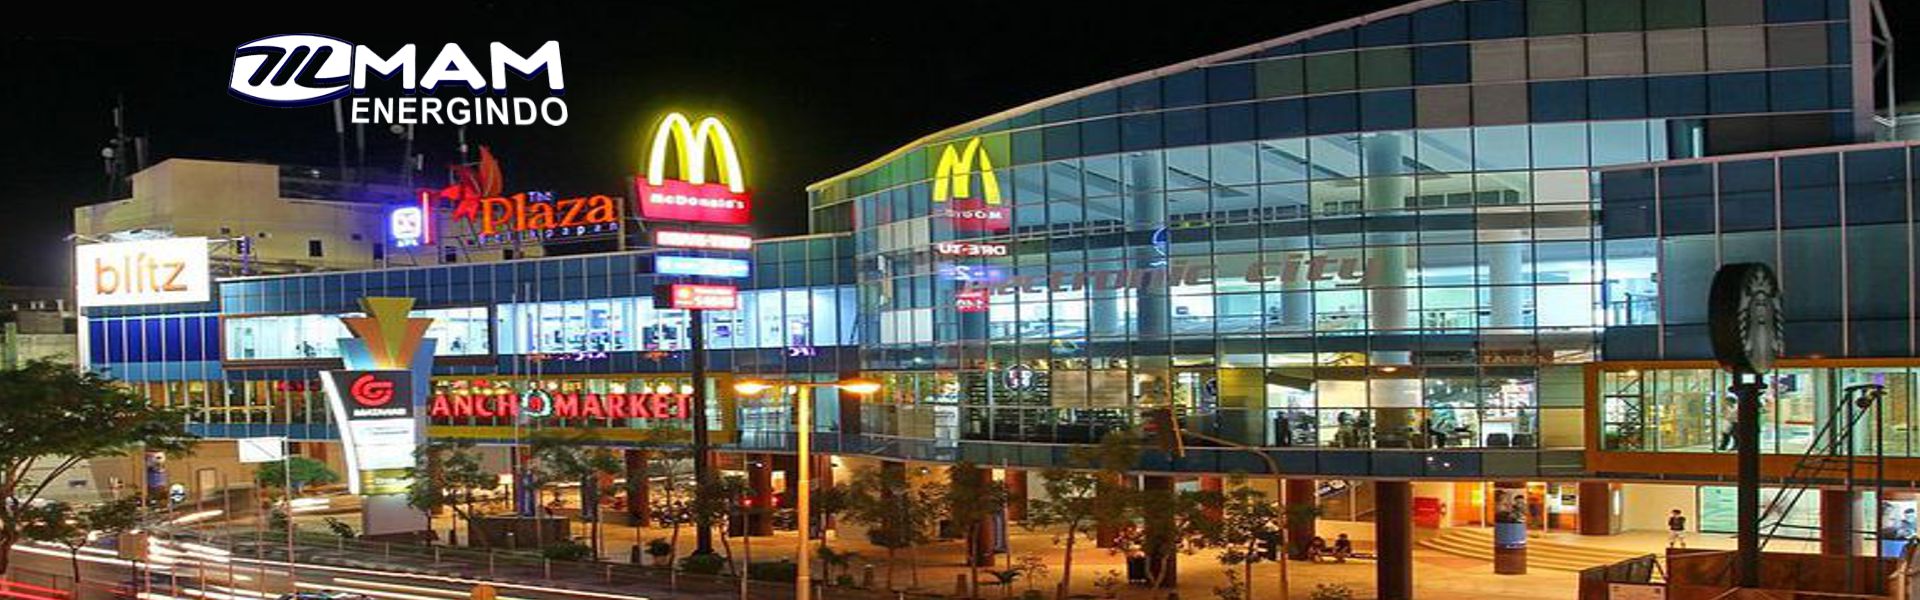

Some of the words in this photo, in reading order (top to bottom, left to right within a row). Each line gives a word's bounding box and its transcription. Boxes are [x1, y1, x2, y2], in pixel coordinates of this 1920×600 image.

[480, 192, 618, 236] Plaza
[649, 193, 745, 209] McDonald's
[95, 252, 188, 295] blitz
[430, 392, 519, 418] ANCH
[554, 392, 692, 419] MARKET
